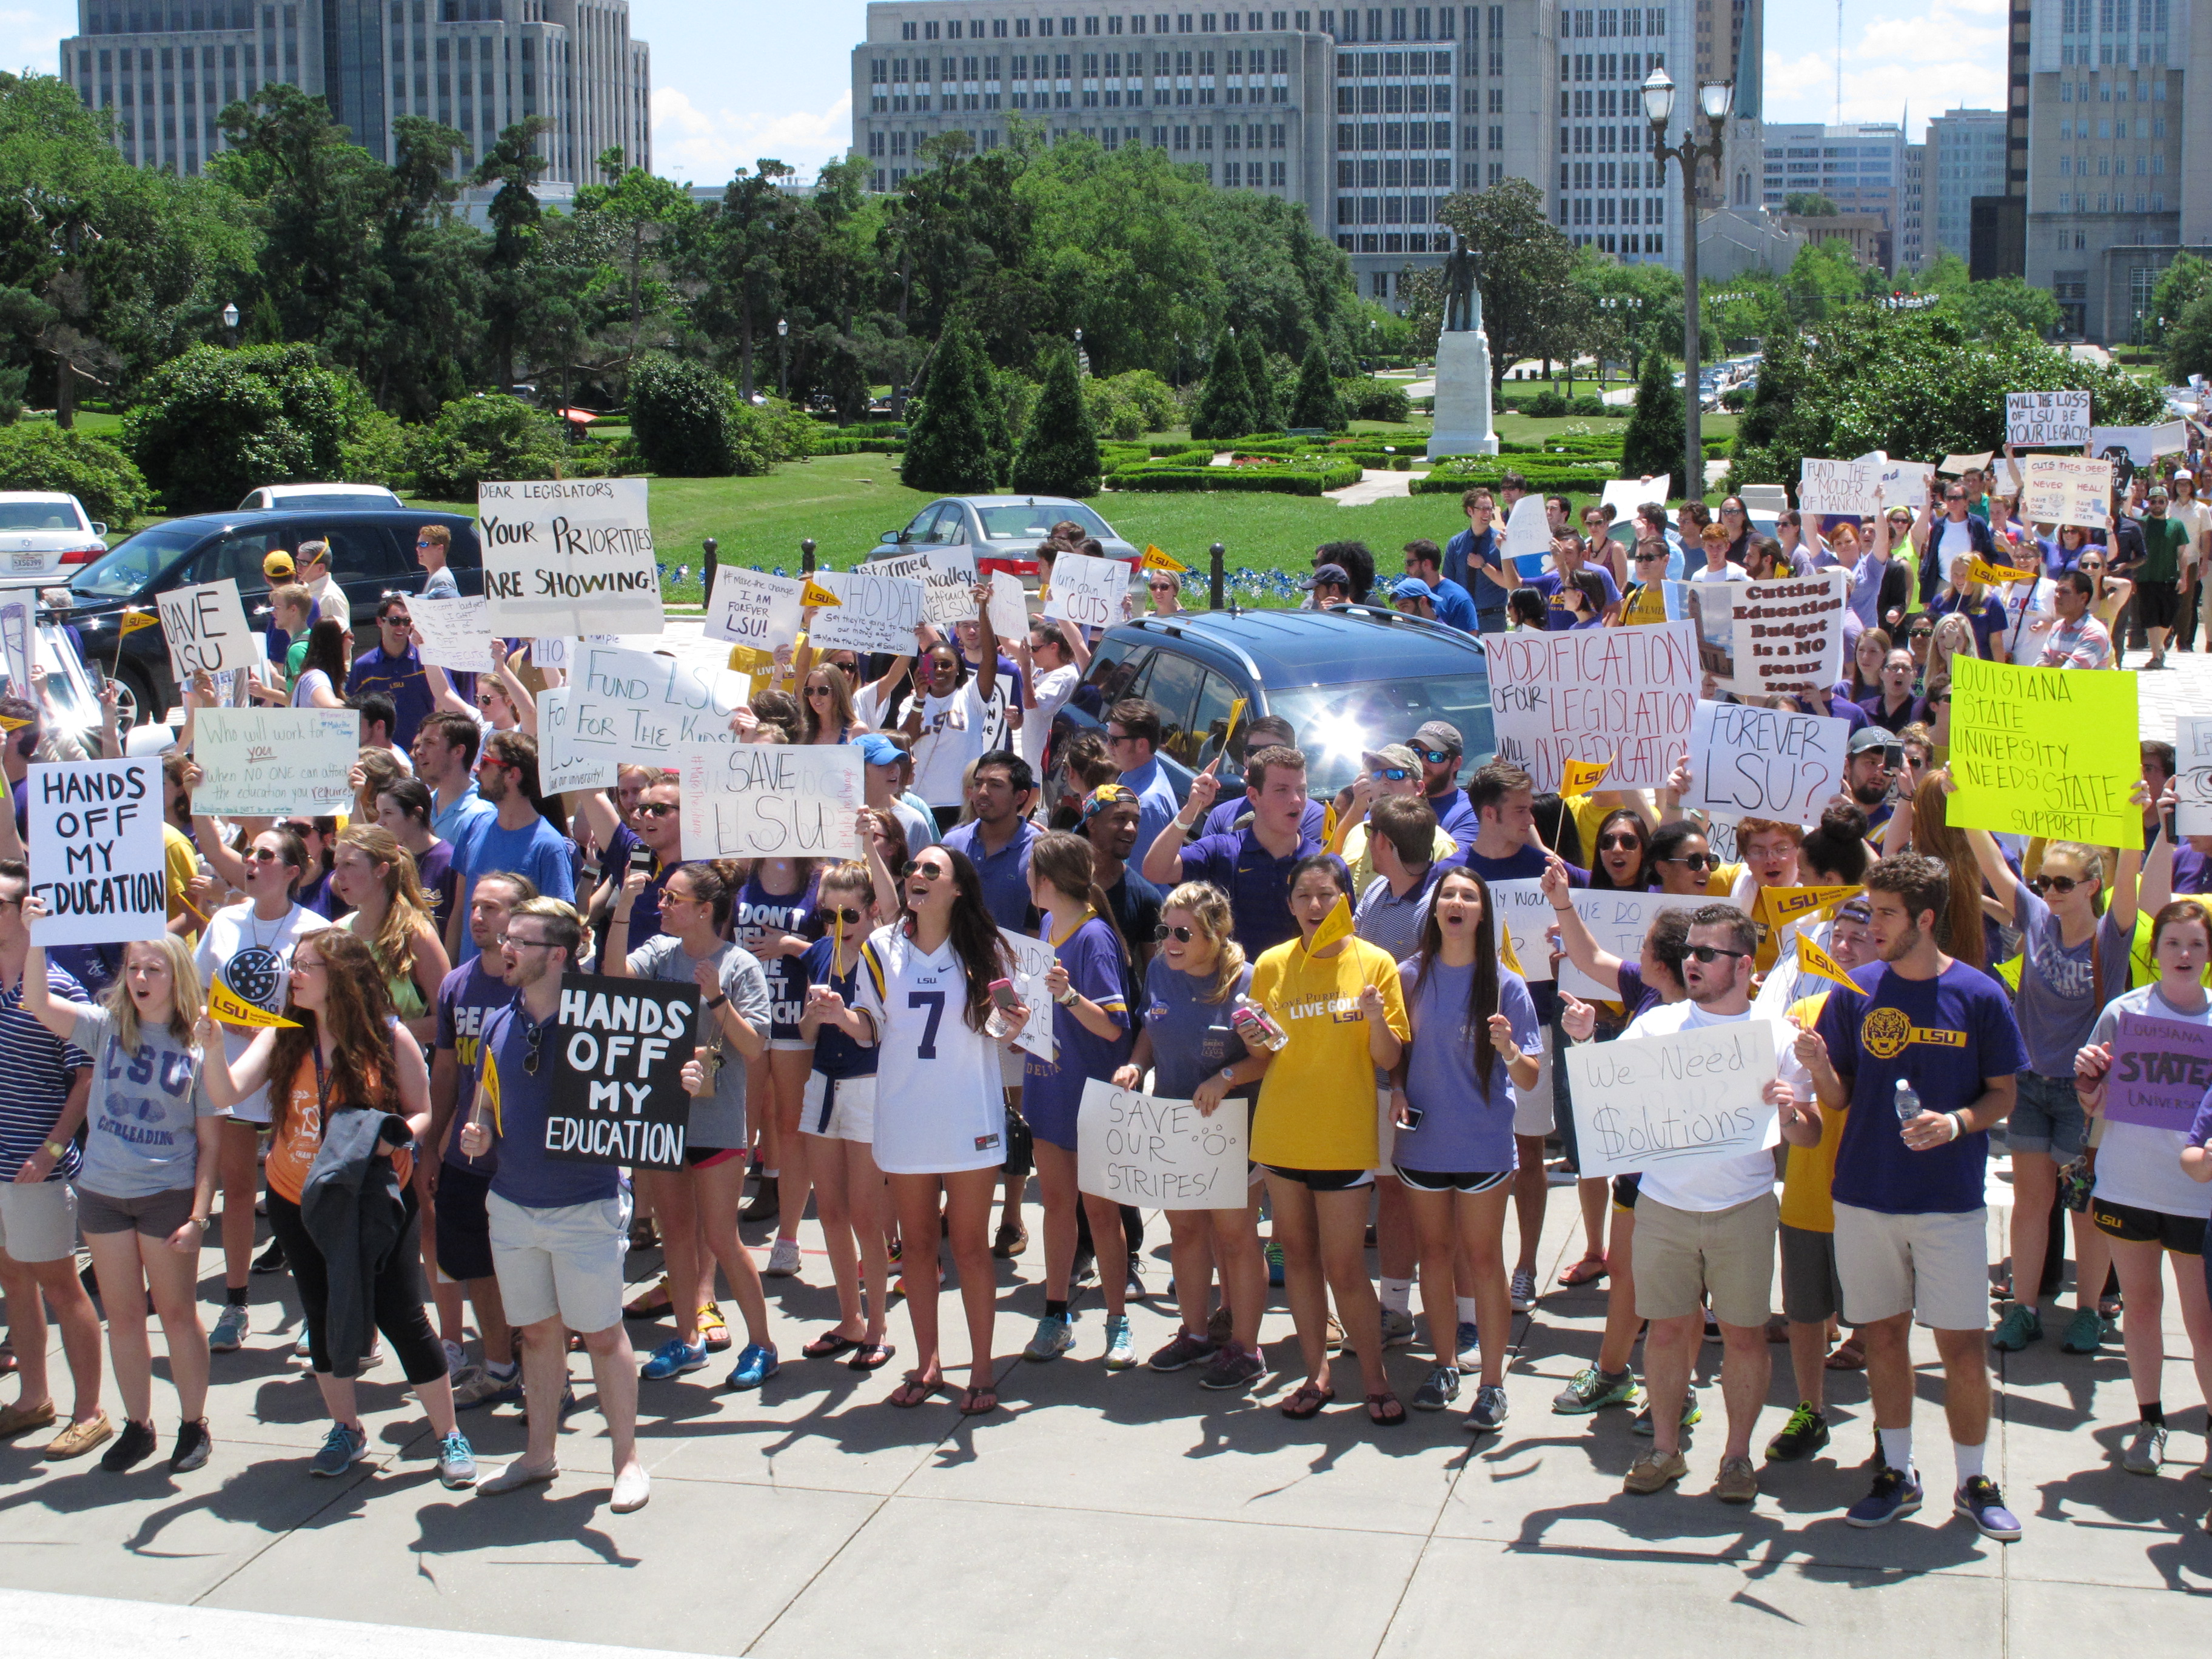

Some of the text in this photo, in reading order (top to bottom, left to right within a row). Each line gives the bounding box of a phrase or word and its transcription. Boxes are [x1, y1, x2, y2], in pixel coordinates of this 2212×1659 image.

[2008, 393, 2088, 409] WILL THE LOSS
[2012, 409, 2077, 423] OF LSU BE
[2008, 424, 2088, 444] YOUR LEGACY?
[1808, 462, 1871, 483] FUND THE
[2031, 461, 2055, 470] CUTS
[2059, 462, 2081, 472] THIS
[480, 483, 614, 499] DEAR LEGISLATORS,
[2077, 483, 2104, 492] HEAL!
[1802, 494, 1870, 512] OF MANKIND
[480, 515, 652, 556] YOUR PRIORITIES
[1149, 554, 1169, 568] LSU
[1974, 568, 1994, 582] LSU
[484, 567, 657, 600] ARE SHOWING!
[1078, 560, 1098, 595] down
[1104, 565, 1116, 597] 4
[1746, 580, 1831, 600] Cutting
[728, 602, 769, 618] FOREVER
[740, 590, 771, 605] I AM
[808, 591, 829, 604] LSU
[886, 579, 923, 626] DAT
[1067, 593, 1108, 624] CUTS
[1732, 598, 1842, 620] Education
[161, 591, 227, 645] SAVE
[726, 614, 768, 638] LSU!
[824, 613, 840, 623] Say
[869, 619, 886, 632] going
[899, 625, 914, 634] take
[1751, 619, 1828, 638] Budget
[176, 642, 223, 679] LSU
[1485, 629, 1692, 685] MODIFICATION
[1753, 638, 1826, 656] is a NO
[1759, 660, 1822, 677] geaux
[1952, 661, 2073, 703] LOUISIANA
[587, 650, 742, 717] FUND LSU
[1493, 685, 1513, 713] OF
[1516, 686, 1547, 712] OUR
[1962, 694, 2024, 728] STATE
[201, 714, 326, 744] Who will work for
[577, 704, 671, 747] FOR THE
[1711, 705, 1825, 760] FOREVER
[247, 746, 272, 757] you
[1496, 736, 1529, 762] WILL
[1954, 727, 2069, 769] UNIVERSITY
[44, 766, 146, 804] HANDS
[244, 768, 263, 780] NO
[269, 767, 295, 780] ONE
[301, 768, 318, 779] can
[322, 763, 347, 778] afford
[726, 751, 795, 793] SAVE
[1574, 769, 1604, 785] LSU
[1704, 748, 1829, 820] LSU?
[212, 784, 307, 803] the education you
[1966, 760, 2121, 813] NEEDS STATE
[56, 803, 138, 837] OFF
[715, 796, 825, 855] LSU
[2011, 808, 2096, 840] SUPPORT!
[67, 840, 114, 875] MY
[32, 870, 164, 916] EDUCATION
[1777, 893, 1818, 913] LSU
[739, 902, 806, 931] DON'T
[1615, 902, 1641, 921] DO
[1806, 949, 1834, 974] LSU
[213, 996, 248, 1020] LSU
[558, 989, 691, 1039] HANDS
[1274, 990, 1349, 1011] LOVE PURPLE
[1290, 1002, 1324, 1019] LIVE
[909, 991, 945, 1059] 7
[1333, 1011, 1364, 1024] LSU
[2124, 1017, 2204, 1043] LOUISIANA
[1920, 1029, 1957, 1044] LSU
[105, 1034, 193, 1098] LSU
[567, 1032, 669, 1078] OFF
[1586, 1034, 1746, 1088] We Need
[1026, 1062, 1062, 1077] DELTA
[589, 1081, 652, 1114] MY
[1110, 1092, 1193, 1134] SAVE
[546, 1116, 683, 1165] EDUCATION
[1593, 1102, 1755, 1158] $olutions
[1107, 1129, 1176, 1164] OUR
[1108, 1162, 1218, 1201] STRIPES!
[2094, 1212, 2122, 1228] LSU
